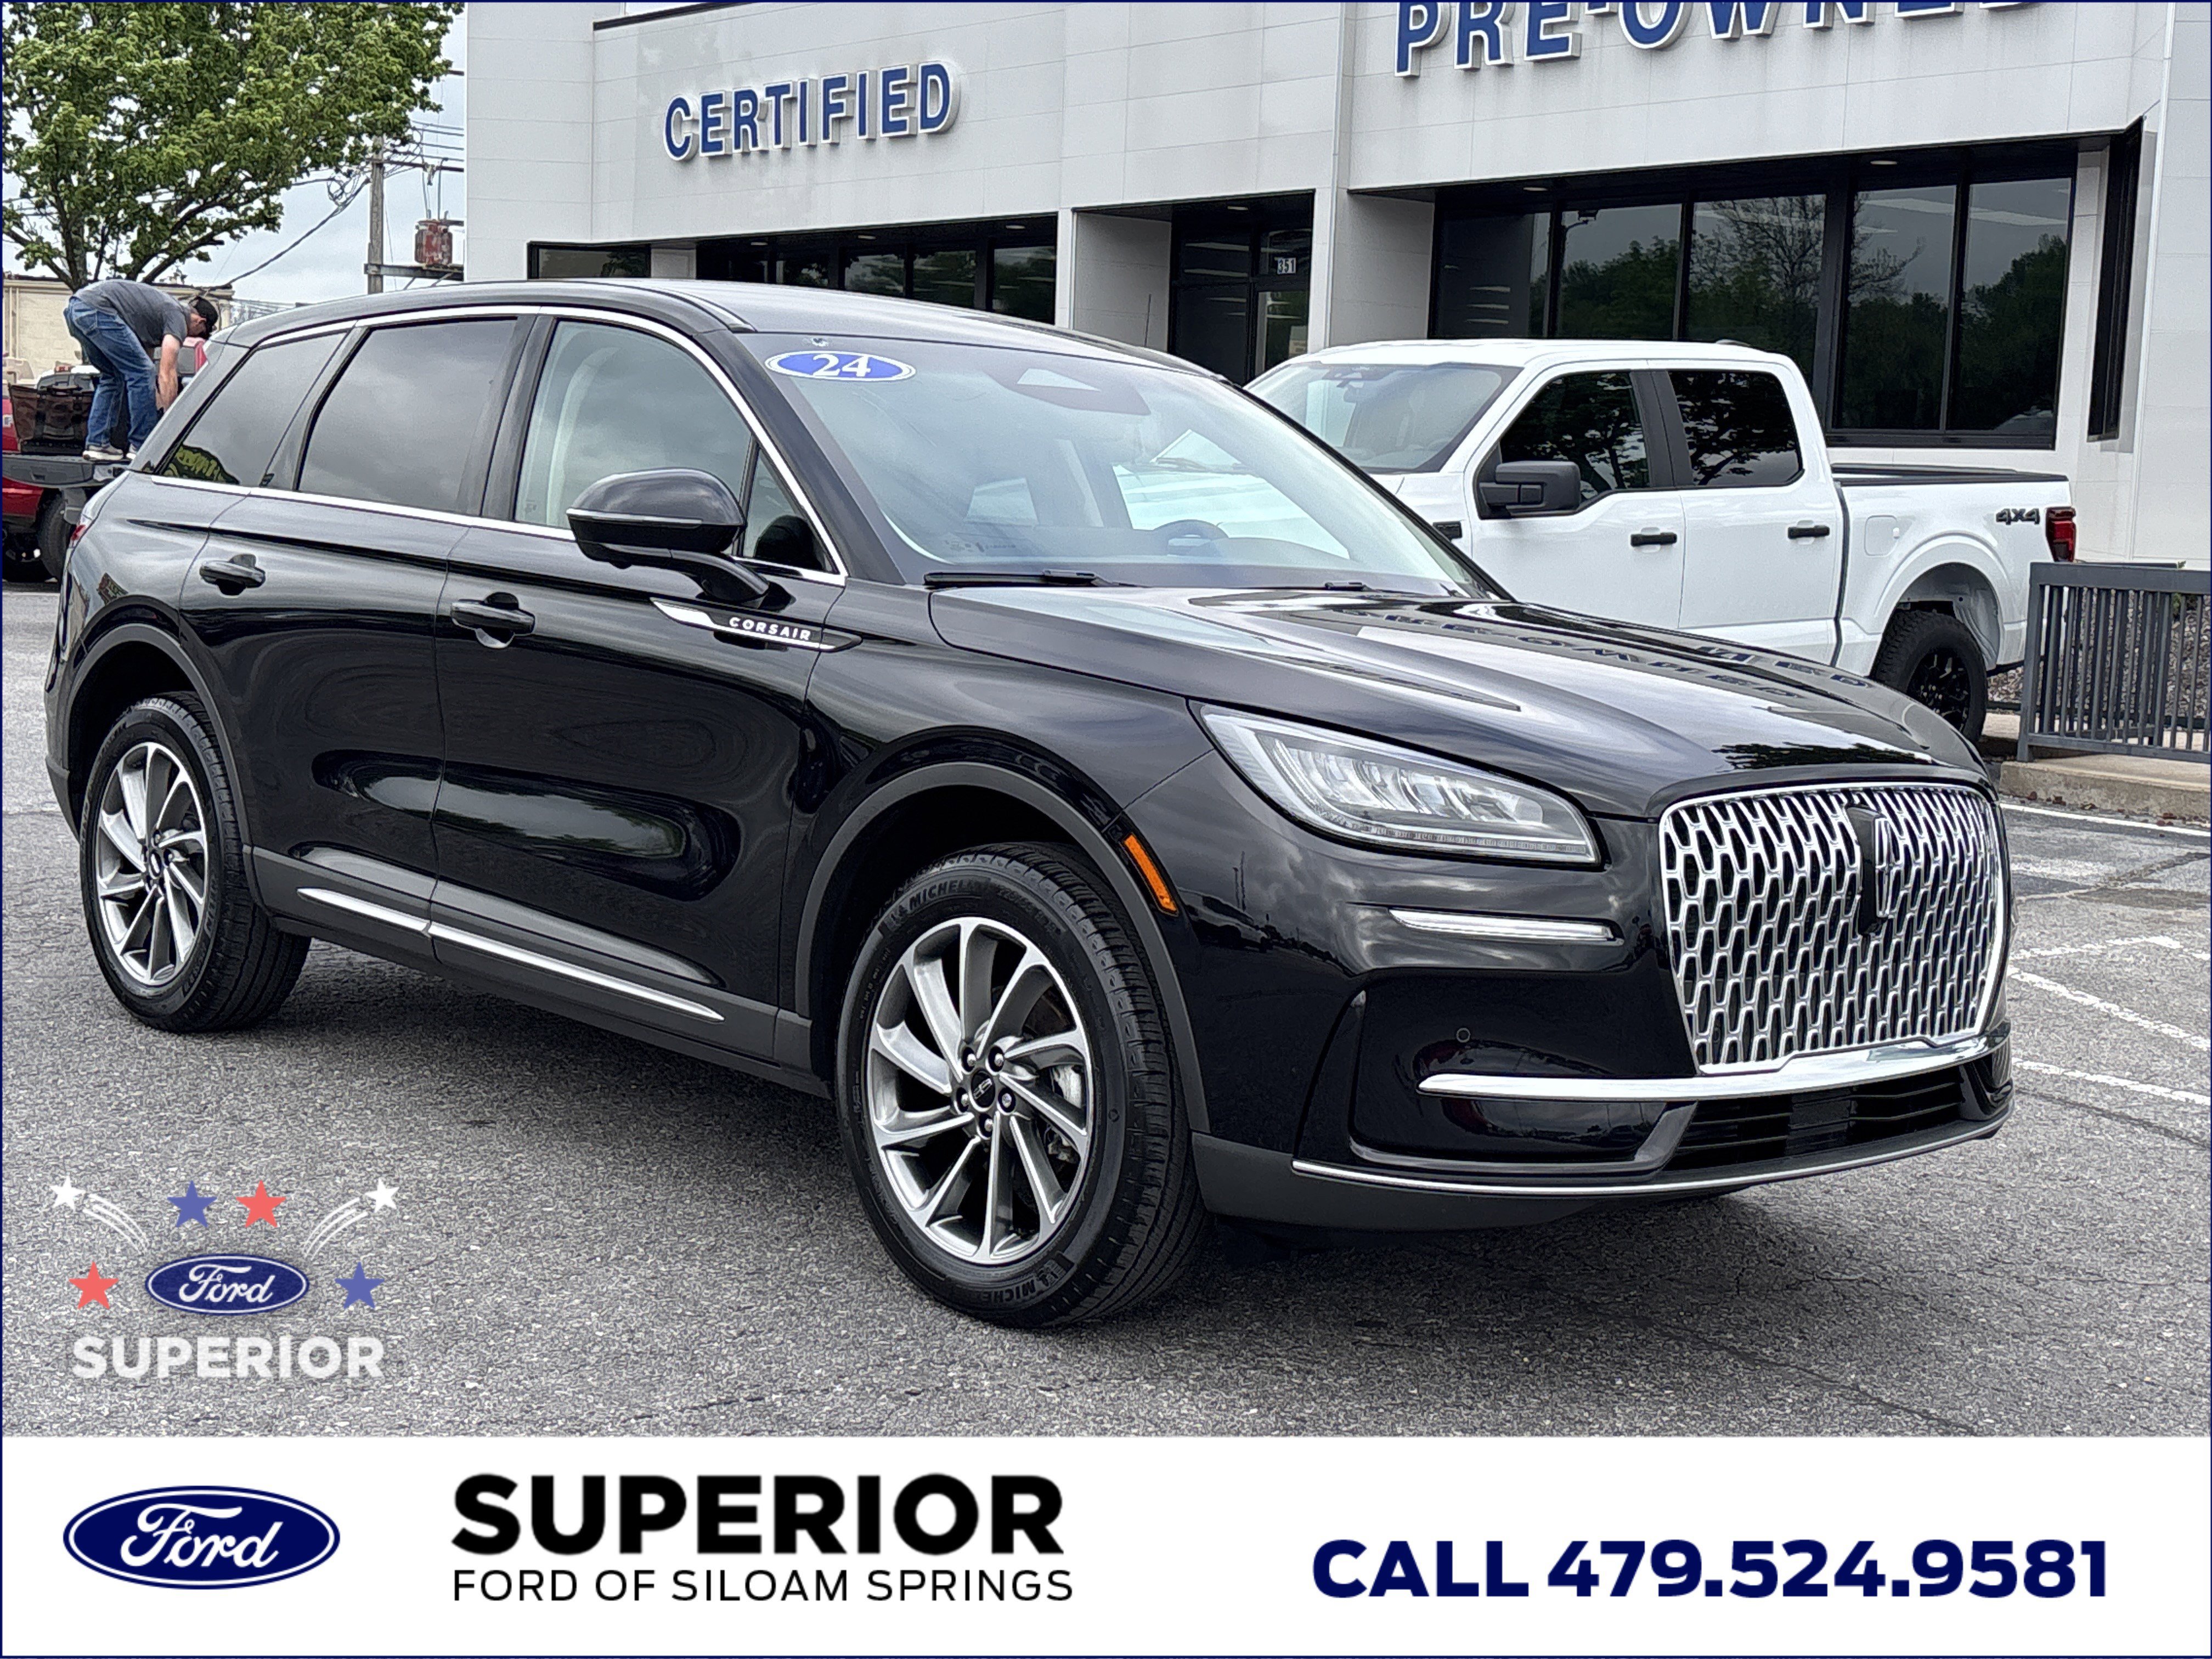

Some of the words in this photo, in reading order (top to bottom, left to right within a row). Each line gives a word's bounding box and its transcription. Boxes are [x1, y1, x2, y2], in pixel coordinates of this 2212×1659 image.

[1394, 2, 2033, 77] PRE-O
[663, 60, 959, 161] CERTIFIED
[1279, 259, 1295, 273] 351
[812, 353, 871, 377] 24
[729, 616, 811, 641] CORSAIR
[977, 1279, 1036, 1304] MICHE
